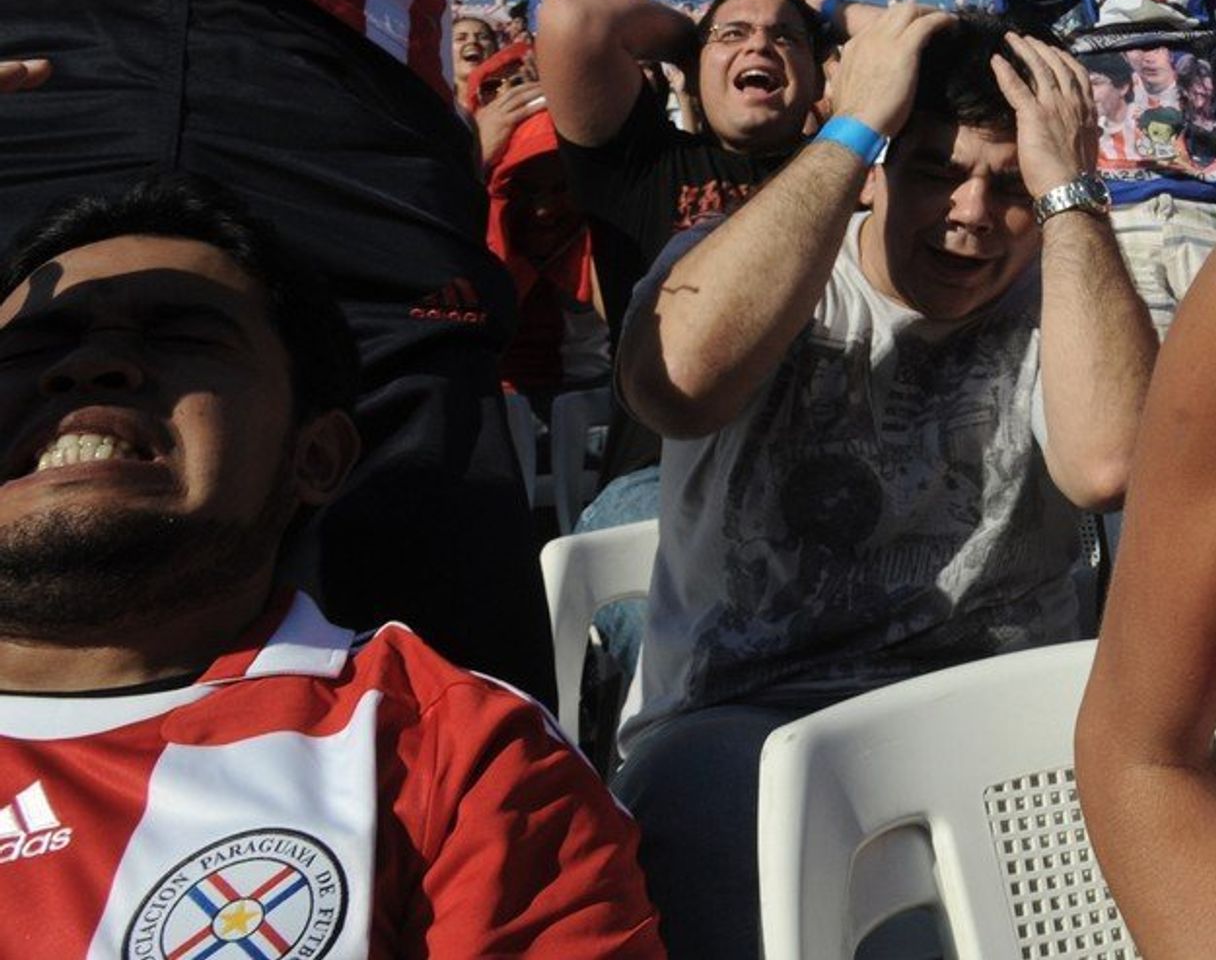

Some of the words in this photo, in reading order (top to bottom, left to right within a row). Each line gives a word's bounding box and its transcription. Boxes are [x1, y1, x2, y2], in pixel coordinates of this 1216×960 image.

[200, 837, 317, 871] PARAGUAYA
[315, 869, 336, 898] DE
[297, 907, 335, 960] FUTB
